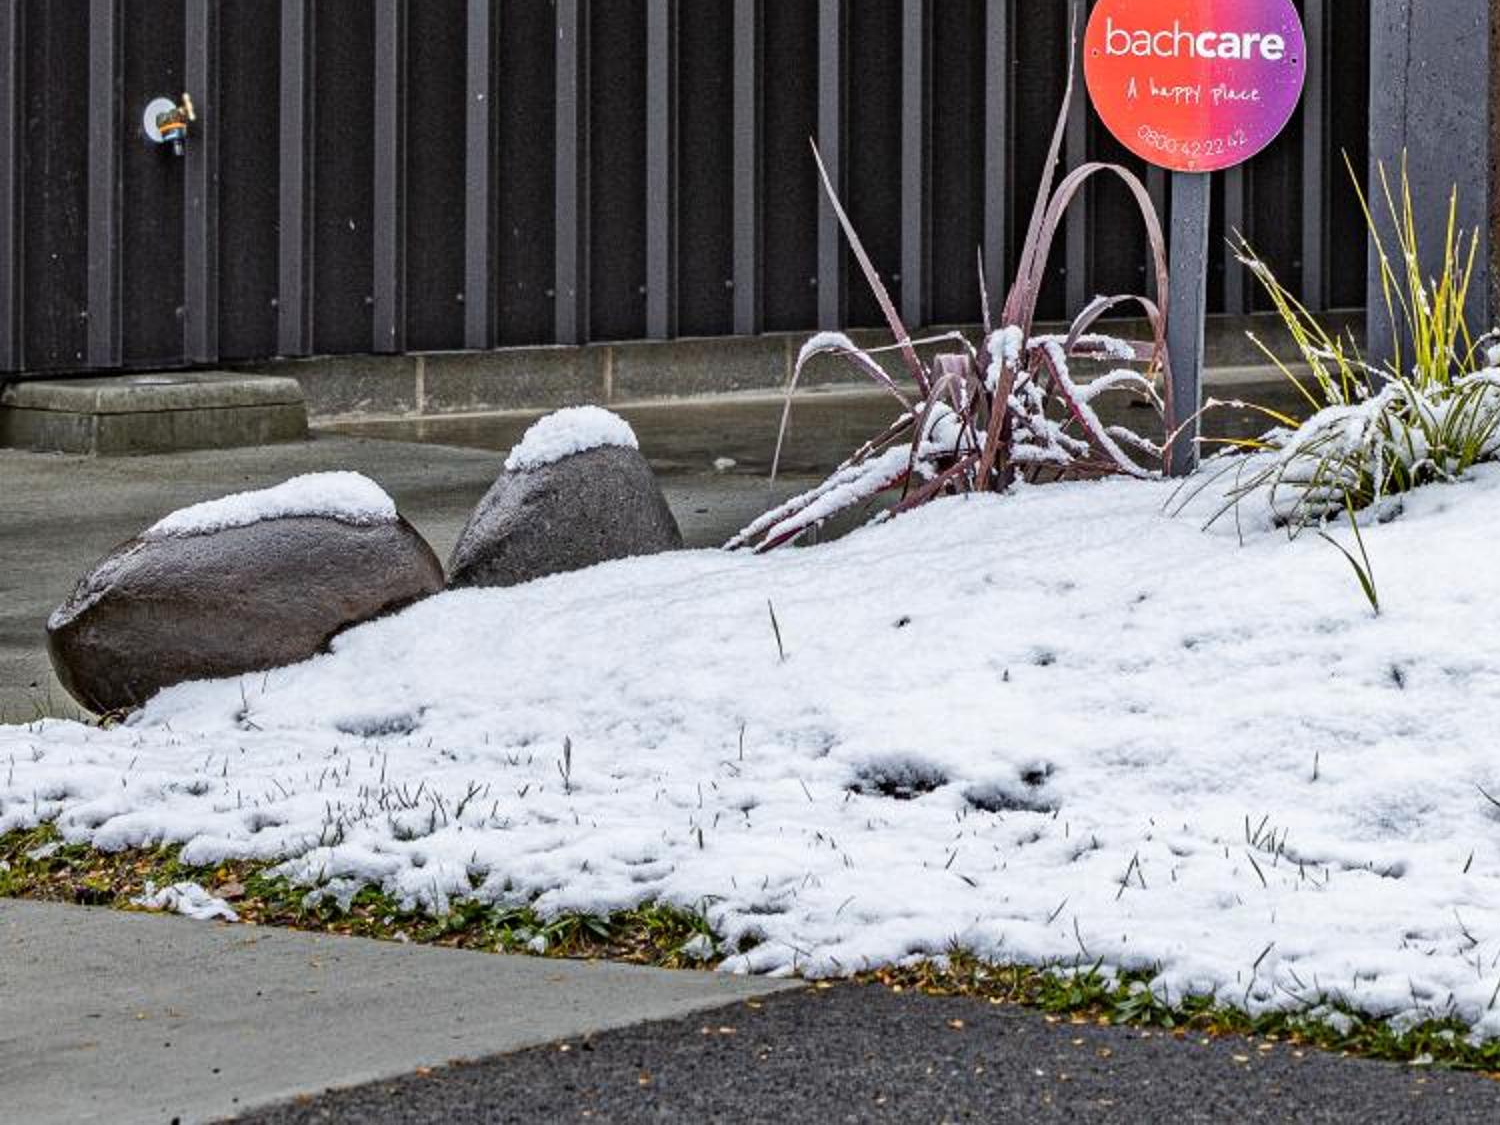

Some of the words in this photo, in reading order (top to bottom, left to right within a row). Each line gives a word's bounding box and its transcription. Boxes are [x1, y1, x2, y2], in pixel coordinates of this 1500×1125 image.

[1105, 17, 1285, 60] bachcare
[1126, 77, 1138, 99] A
[1149, 78, 1200, 104] happy
[1211, 83, 1261, 105] place
